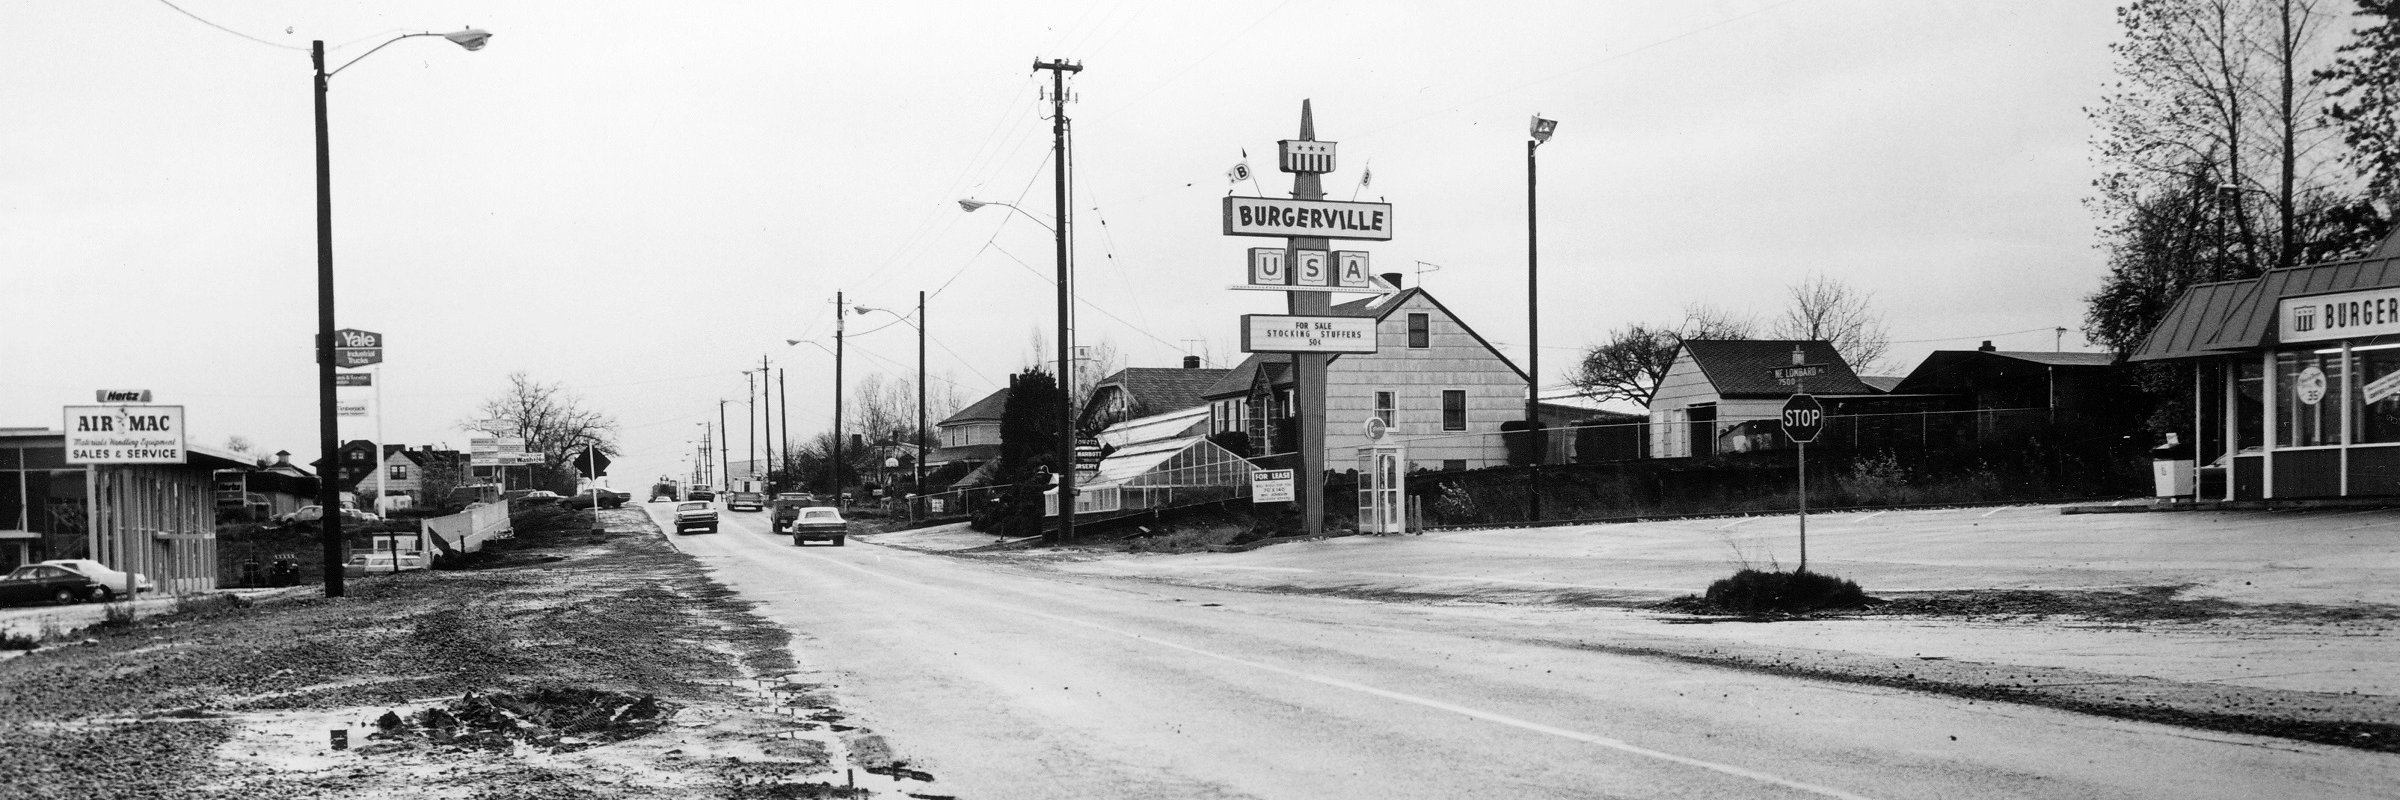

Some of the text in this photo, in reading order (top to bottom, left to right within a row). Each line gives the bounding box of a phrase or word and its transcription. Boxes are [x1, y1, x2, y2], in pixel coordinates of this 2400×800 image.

[1236, 166, 1247, 178] B
[1239, 205, 1384, 231] BURGERVILLE
[1262, 256, 1361, 279] U S A
[2325, 297, 2399, 329] BURGER
[1295, 321, 1332, 330] FOR SALE
[342, 331, 376, 347] Yale
[1266, 329, 1362, 339] STOCKING STUFFERS
[1774, 368, 1783, 378] NE
[1785, 367, 1817, 378] LOMBARD
[1779, 378, 1796, 386] 7500
[107, 391, 140, 401] Hertz
[77, 415, 170, 432] AIR MAC
[1785, 409, 1820, 427] STOP
[140, 439, 176, 448] Equipment
[73, 449, 177, 458] SALES & SERVICE
[1255, 472, 1291, 481] FOR LEASE
